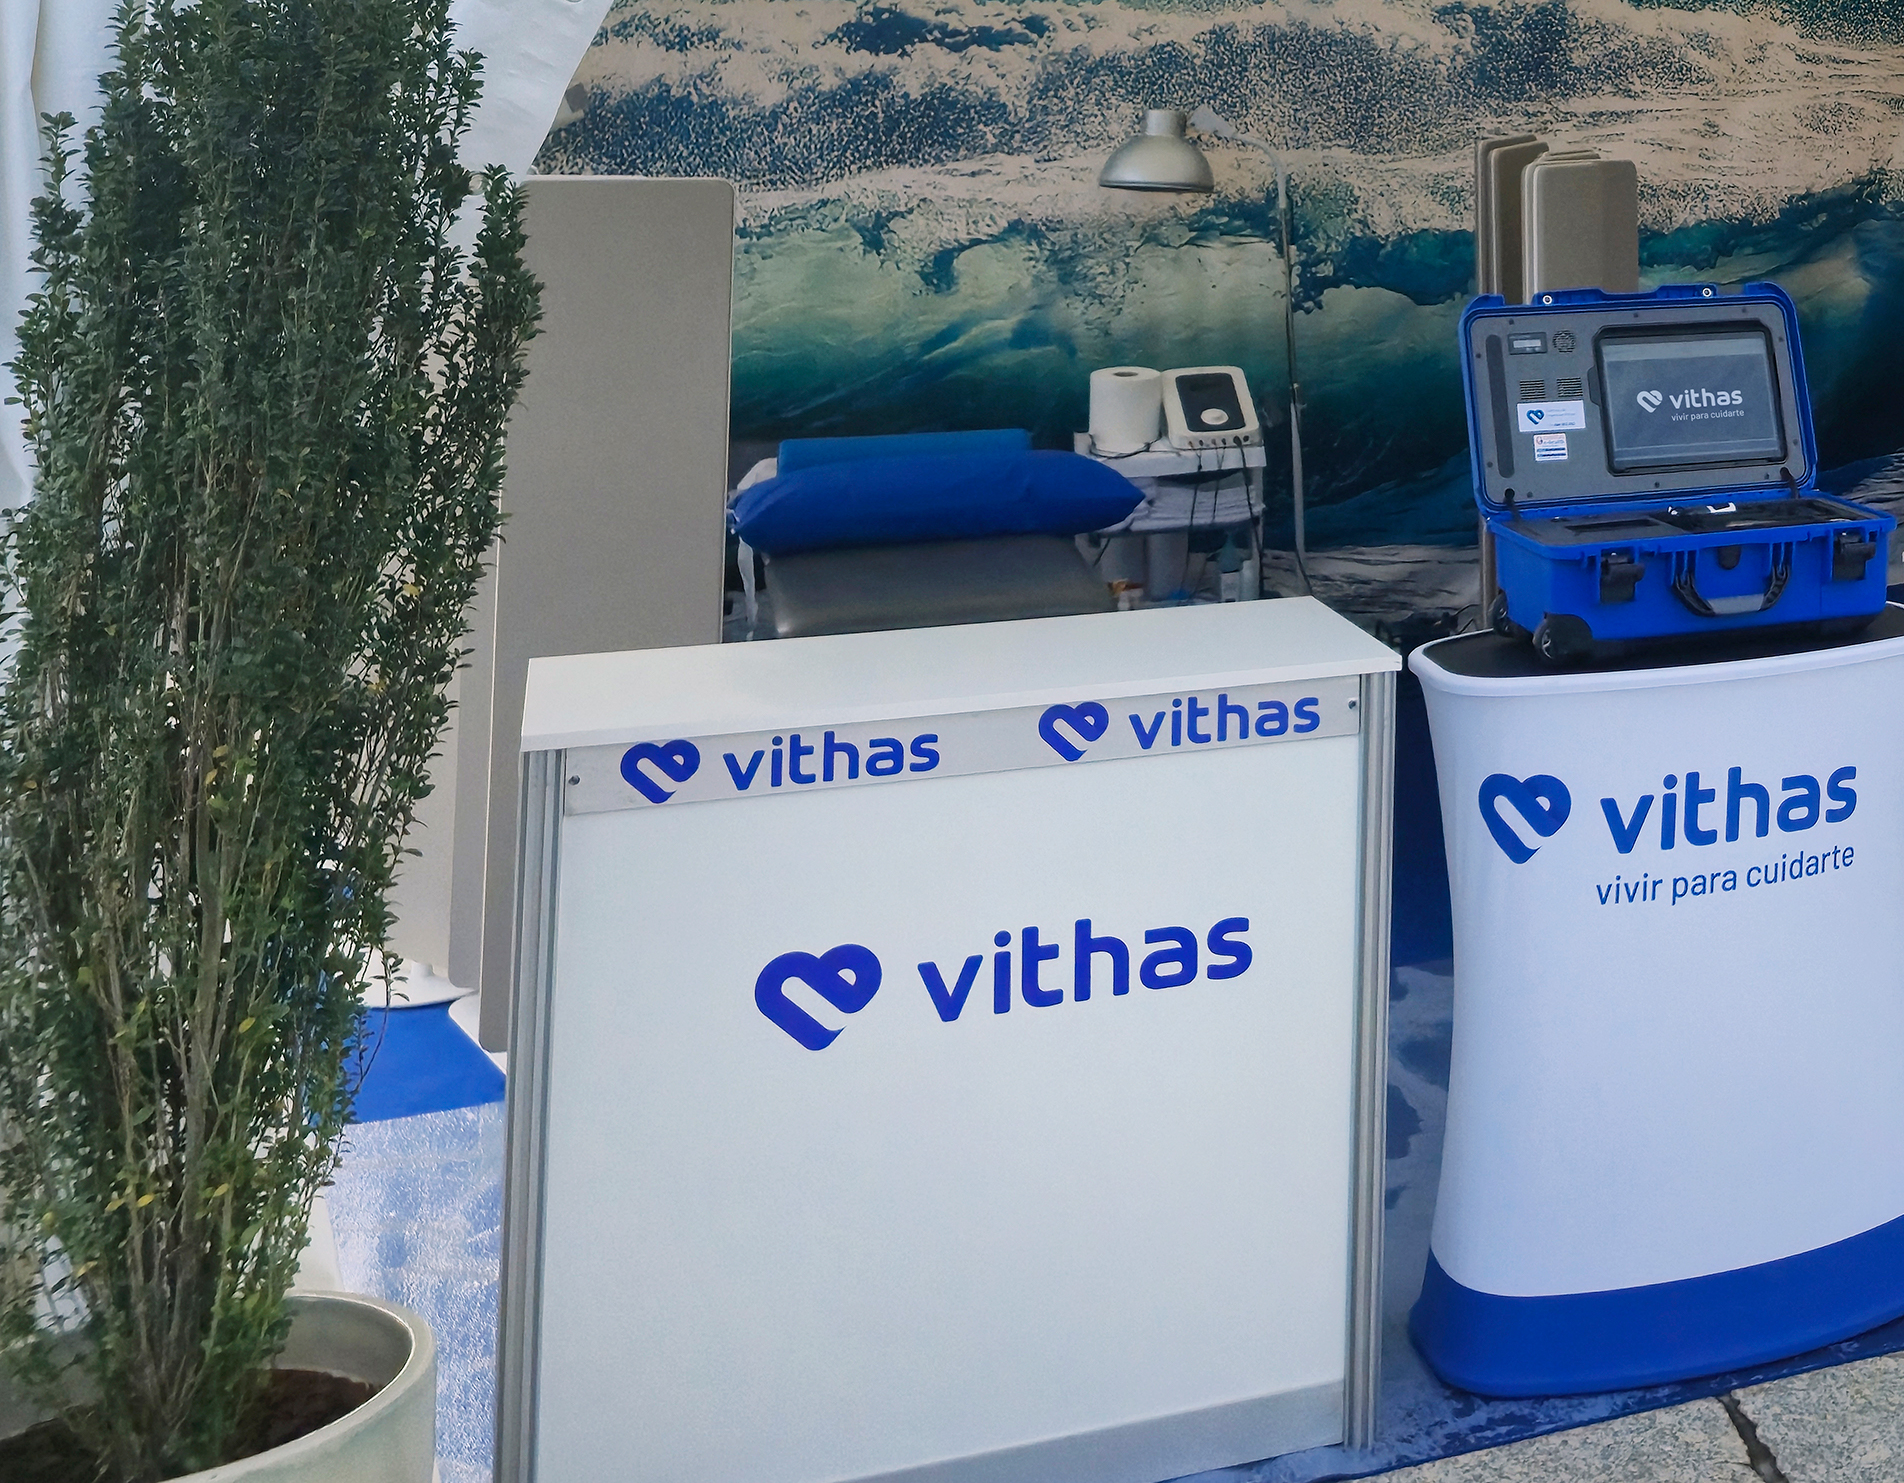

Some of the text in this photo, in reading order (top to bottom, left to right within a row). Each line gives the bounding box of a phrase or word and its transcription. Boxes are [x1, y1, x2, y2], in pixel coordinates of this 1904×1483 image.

[1669, 388, 1744, 410] vithas
[1671, 408, 1745, 422] vivir para cuidarte
[1129, 693, 1321, 750] vithas
[722, 730, 940, 791] vithas
[1600, 766, 1857, 855] vithas
[1596, 844, 1856, 906] vivir para cuidarte
[917, 916, 1253, 1023] vithas
